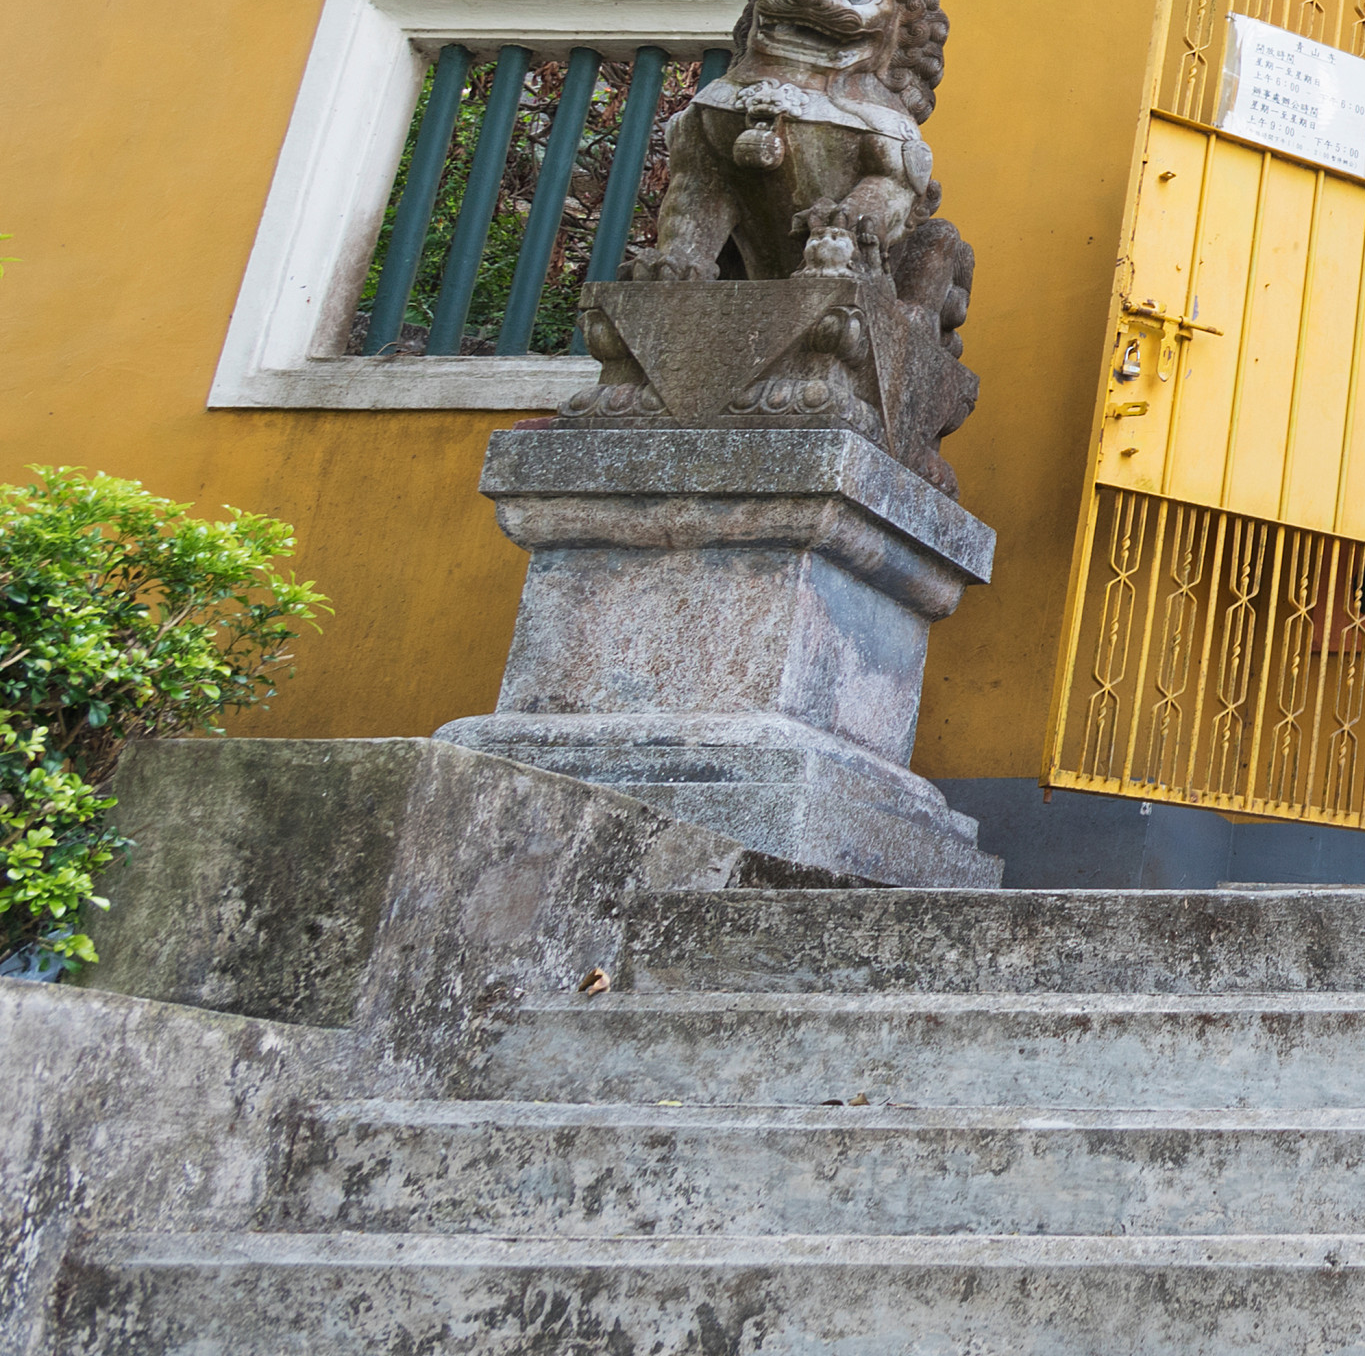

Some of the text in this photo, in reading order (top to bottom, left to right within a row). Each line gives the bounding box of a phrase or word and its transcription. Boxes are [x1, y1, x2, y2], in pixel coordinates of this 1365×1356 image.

[1256, 43, 1295, 65] 開放時間
[1296, 41, 1336, 64] 青山寺
[1255, 57, 1321, 87] 星期一至星期日
[1249, 100, 1317, 131] 星期一至星期日
